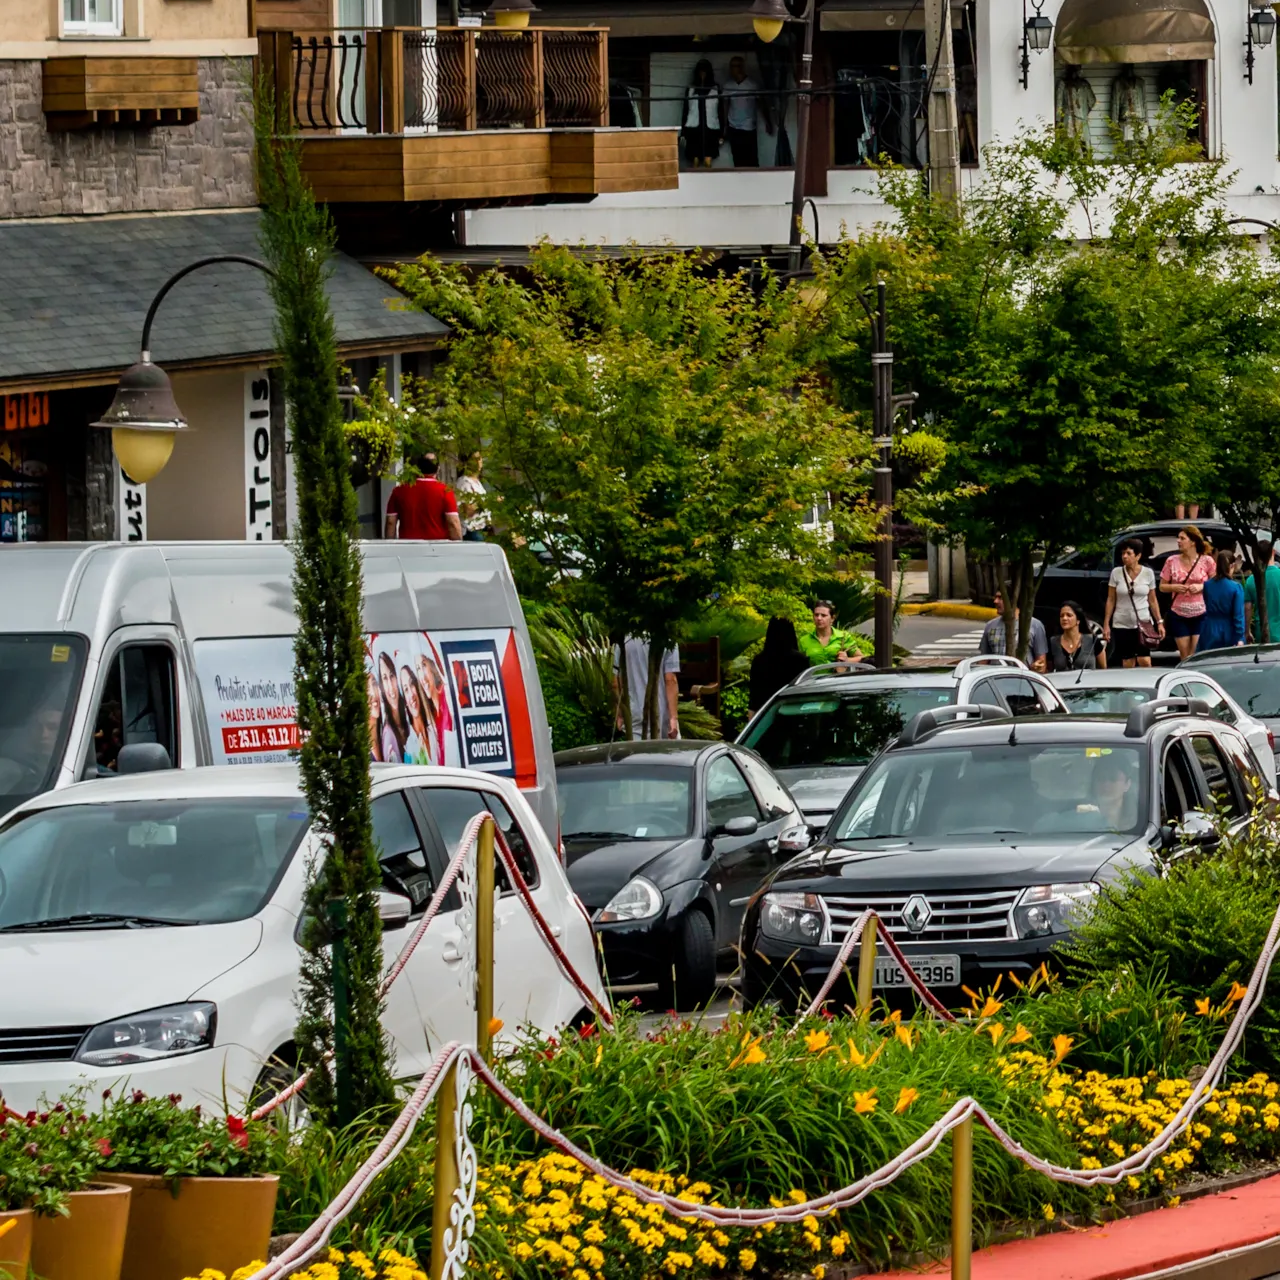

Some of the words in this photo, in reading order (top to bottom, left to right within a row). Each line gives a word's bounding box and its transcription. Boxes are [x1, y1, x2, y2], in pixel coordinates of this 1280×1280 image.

[470, 664, 495, 682] BOTA
[474, 684, 500, 703] FORA
[225, 708, 245, 722] MAIS
[245, 708, 256, 721] DE
[256, 706, 266, 720] 40
[266, 705, 297, 720] MARCAS
[227, 734, 239, 749] DE
[238, 729, 261, 748] 25.11
[261, 732, 269, 746] A
[267, 726, 290, 746] 31.12
[466, 720, 503, 738] GRAMADO
[471, 741, 504, 758] OUTLETS
